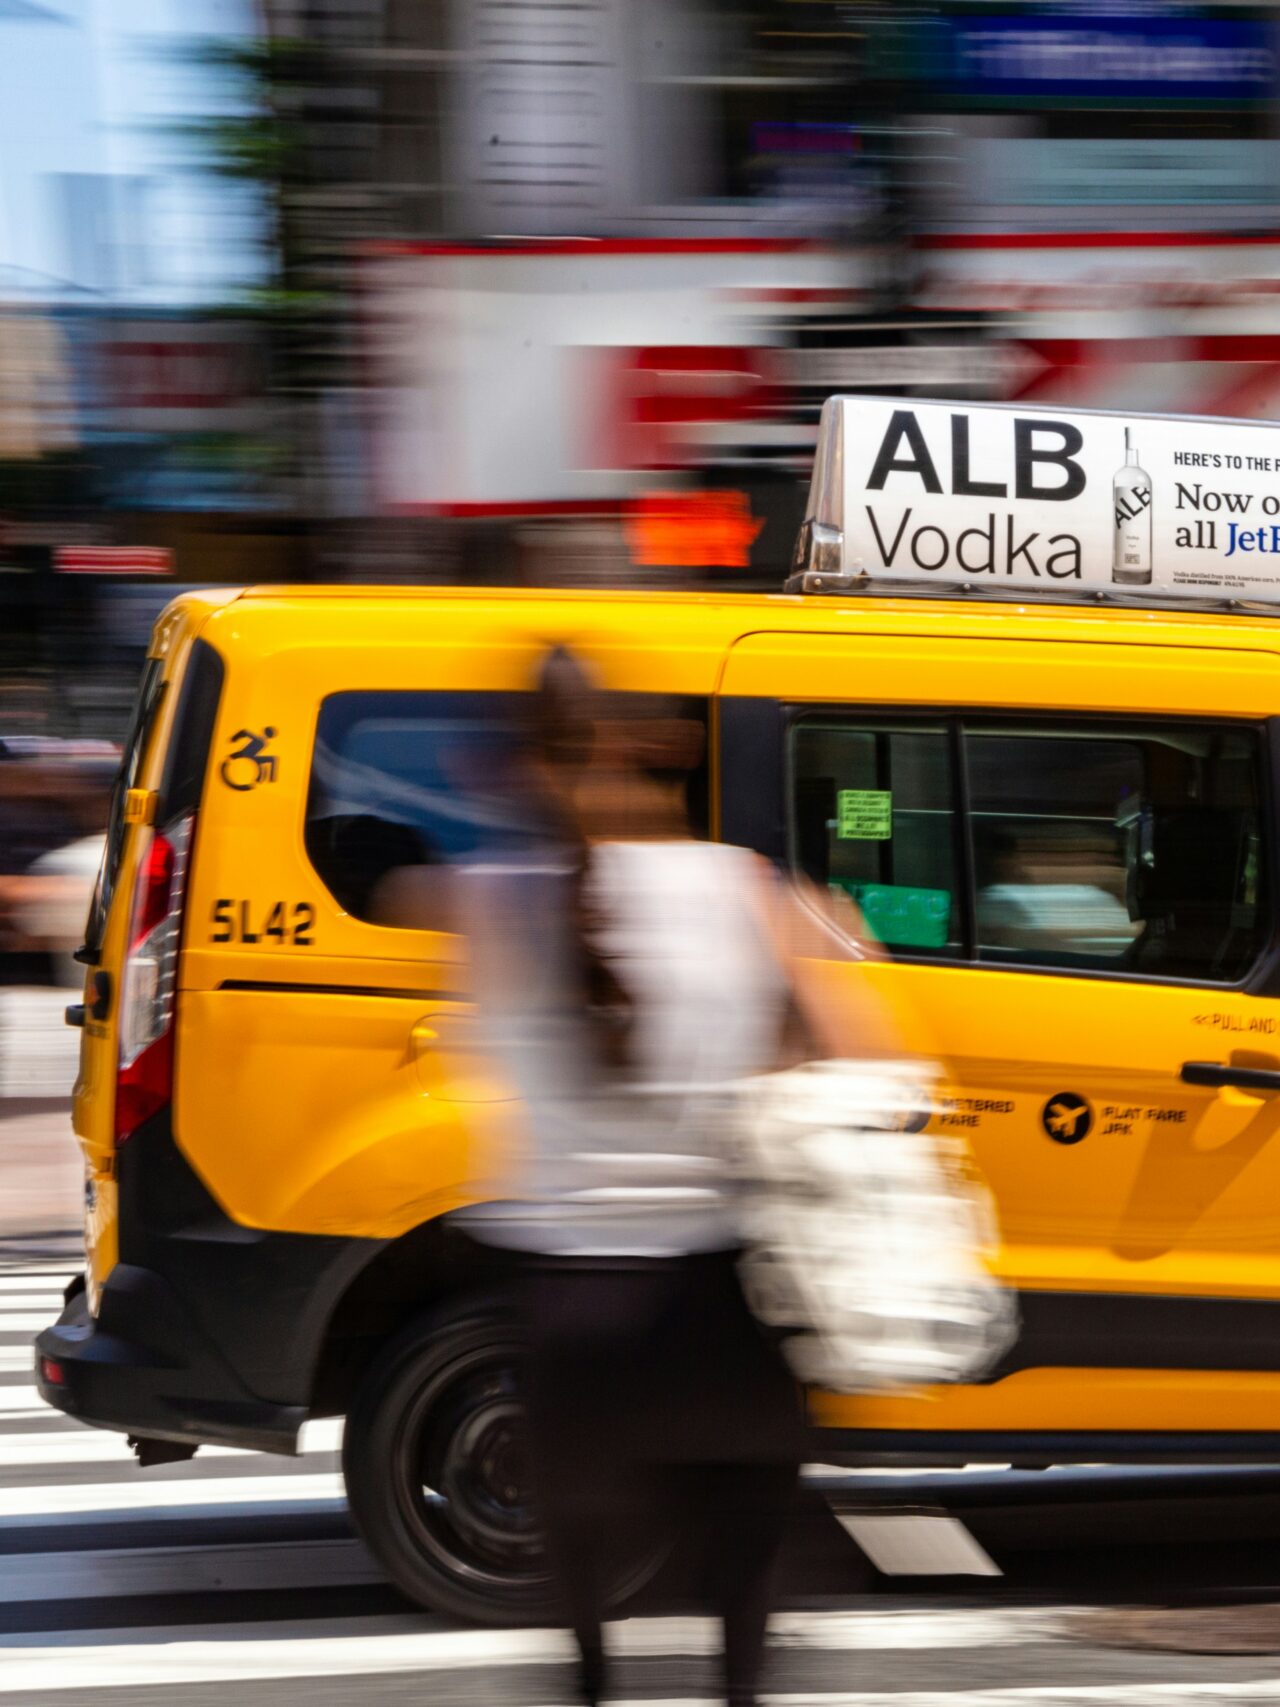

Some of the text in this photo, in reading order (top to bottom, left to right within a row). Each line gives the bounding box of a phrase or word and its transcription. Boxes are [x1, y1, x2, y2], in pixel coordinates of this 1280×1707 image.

[865, 409, 1087, 501] ALB
[1174, 451, 1222, 468] HERE'S
[1224, 455, 1242, 470] TO
[1245, 456, 1271, 472] THE
[1115, 486, 1151, 530] ALB
[1174, 482, 1253, 513] Now
[865, 505, 1082, 579] Vodka
[1175, 520, 1218, 550] all
[209, 898, 316, 946] 5L42
[1211, 1013, 1246, 1032] PULL
[1248, 1016, 1276, 1034] AND
[940, 1113, 981, 1128] FARE
[1103, 1106, 1187, 1123] FLAT FARE
